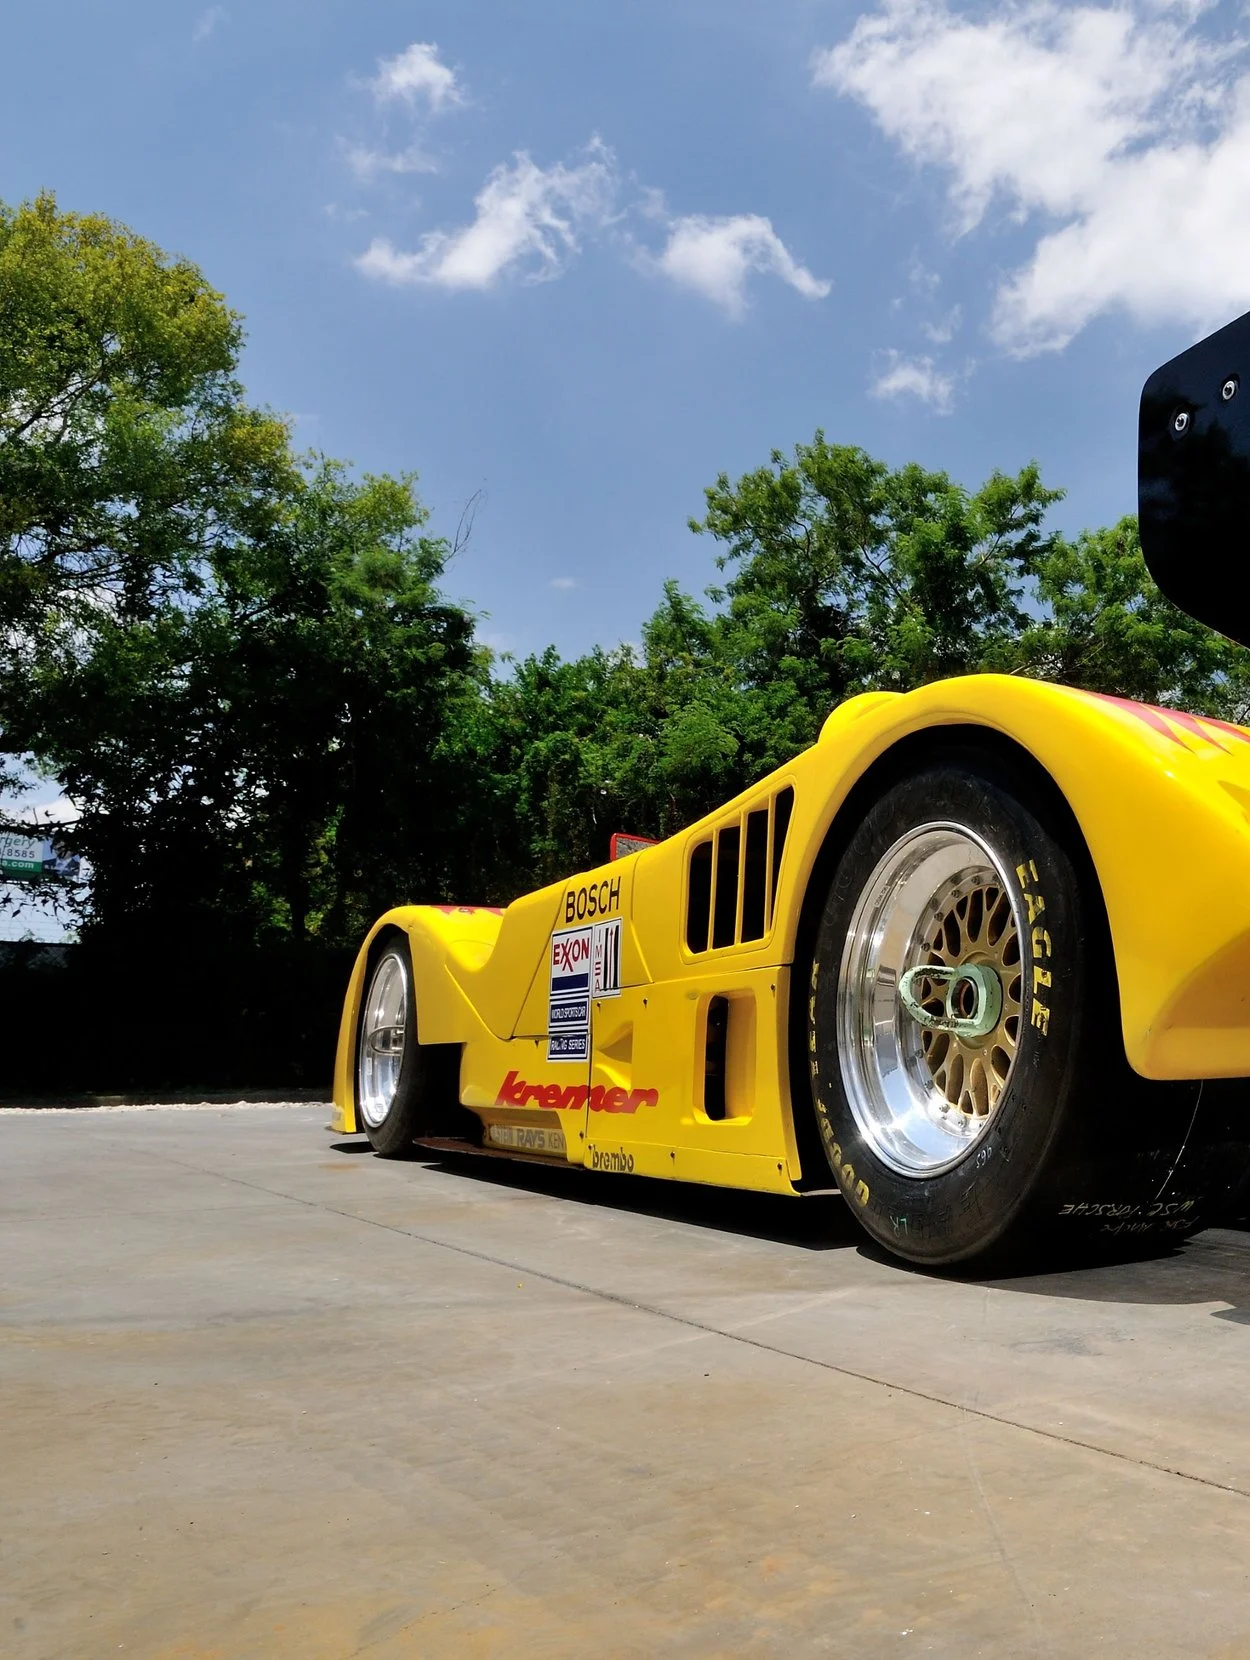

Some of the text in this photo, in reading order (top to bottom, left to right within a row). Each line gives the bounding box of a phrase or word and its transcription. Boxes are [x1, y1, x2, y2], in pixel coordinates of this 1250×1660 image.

[565, 876, 621, 924] BOSCH
[553, 937, 590, 972] EXXON
[1015, 859, 1052, 1037] EAGLE
[568, 1038, 586, 1051] SERIES
[494, 1070, 659, 1114] kremer
[516, 1127, 545, 1149] RAYS
[592, 1144, 634, 1172] brembo
[976, 1144, 992, 1169] 965
[889, 1215, 909, 1238] LR
